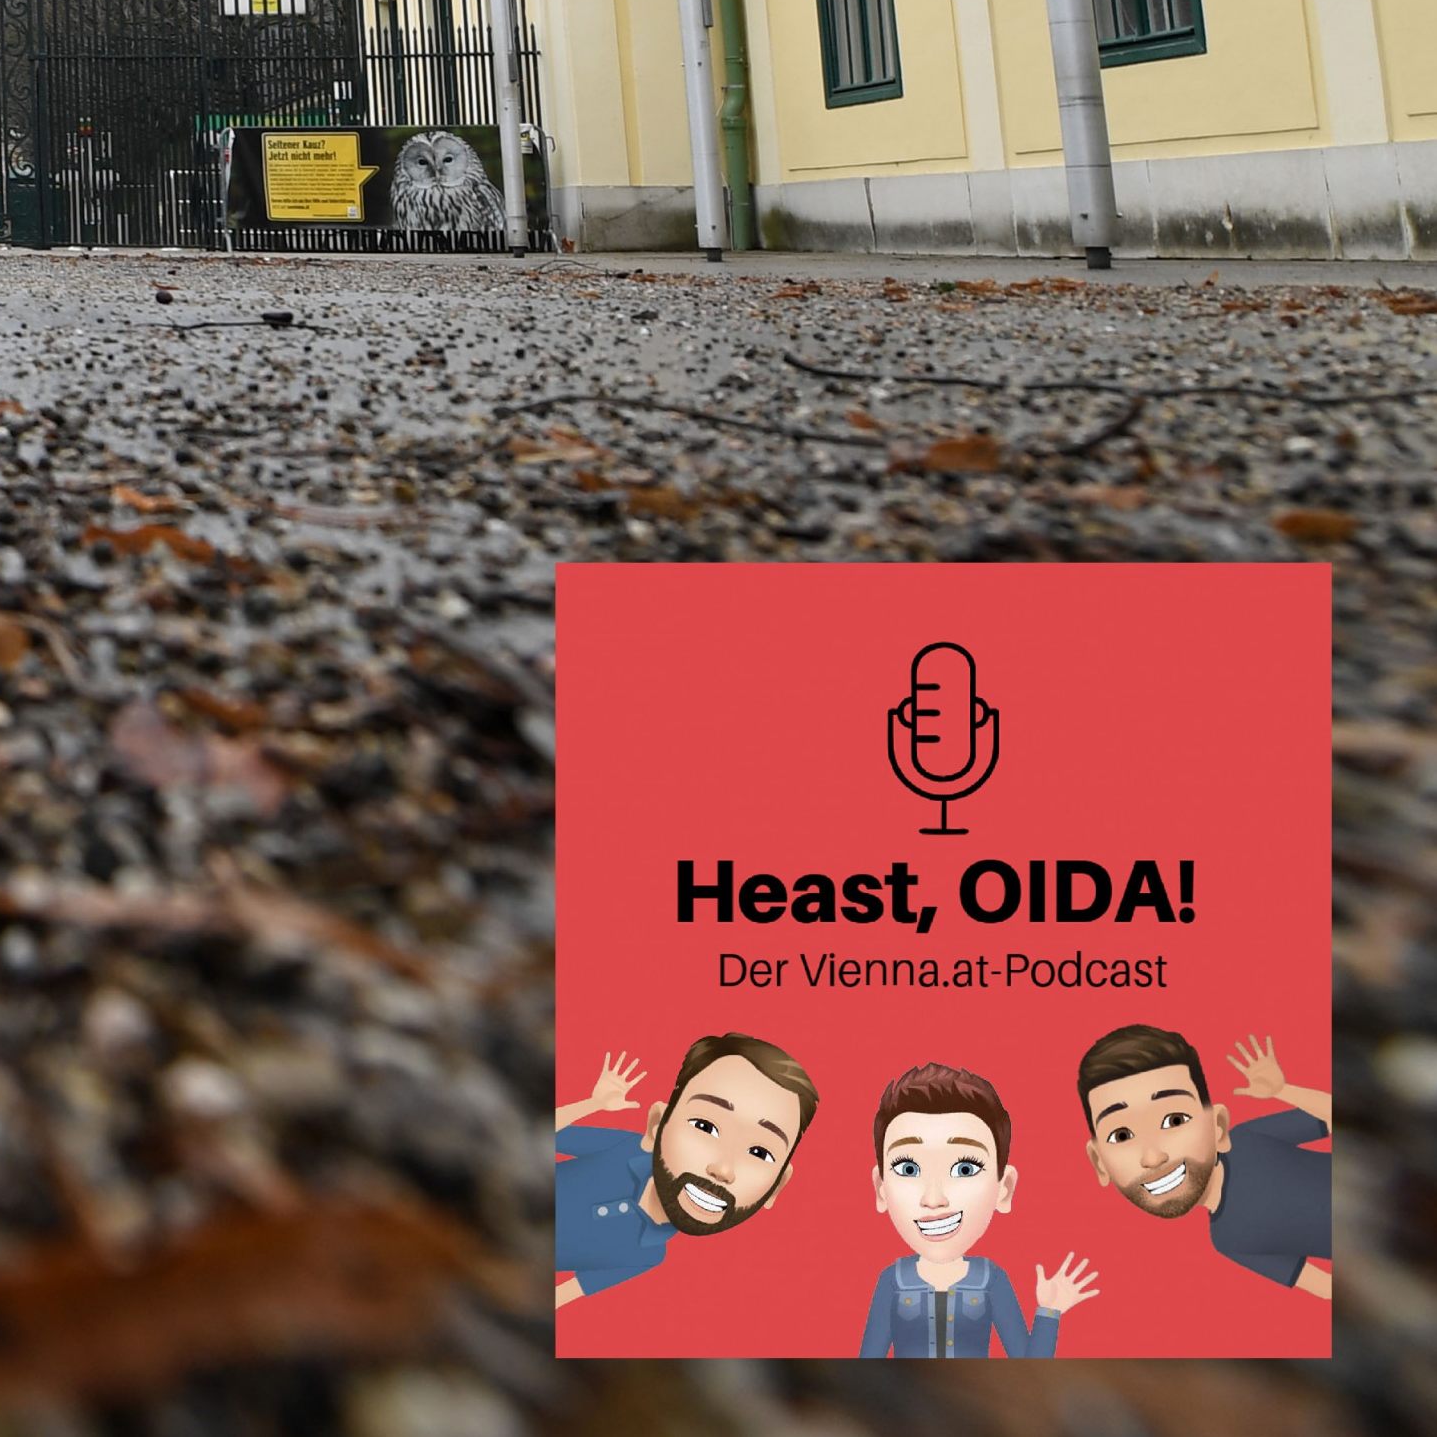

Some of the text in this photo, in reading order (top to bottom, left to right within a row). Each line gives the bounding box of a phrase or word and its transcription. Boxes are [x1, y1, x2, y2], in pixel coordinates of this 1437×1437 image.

[268, 139, 326, 150] Seltener Kauz?
[269, 151, 337, 161] Jetzt nicht mehr!
